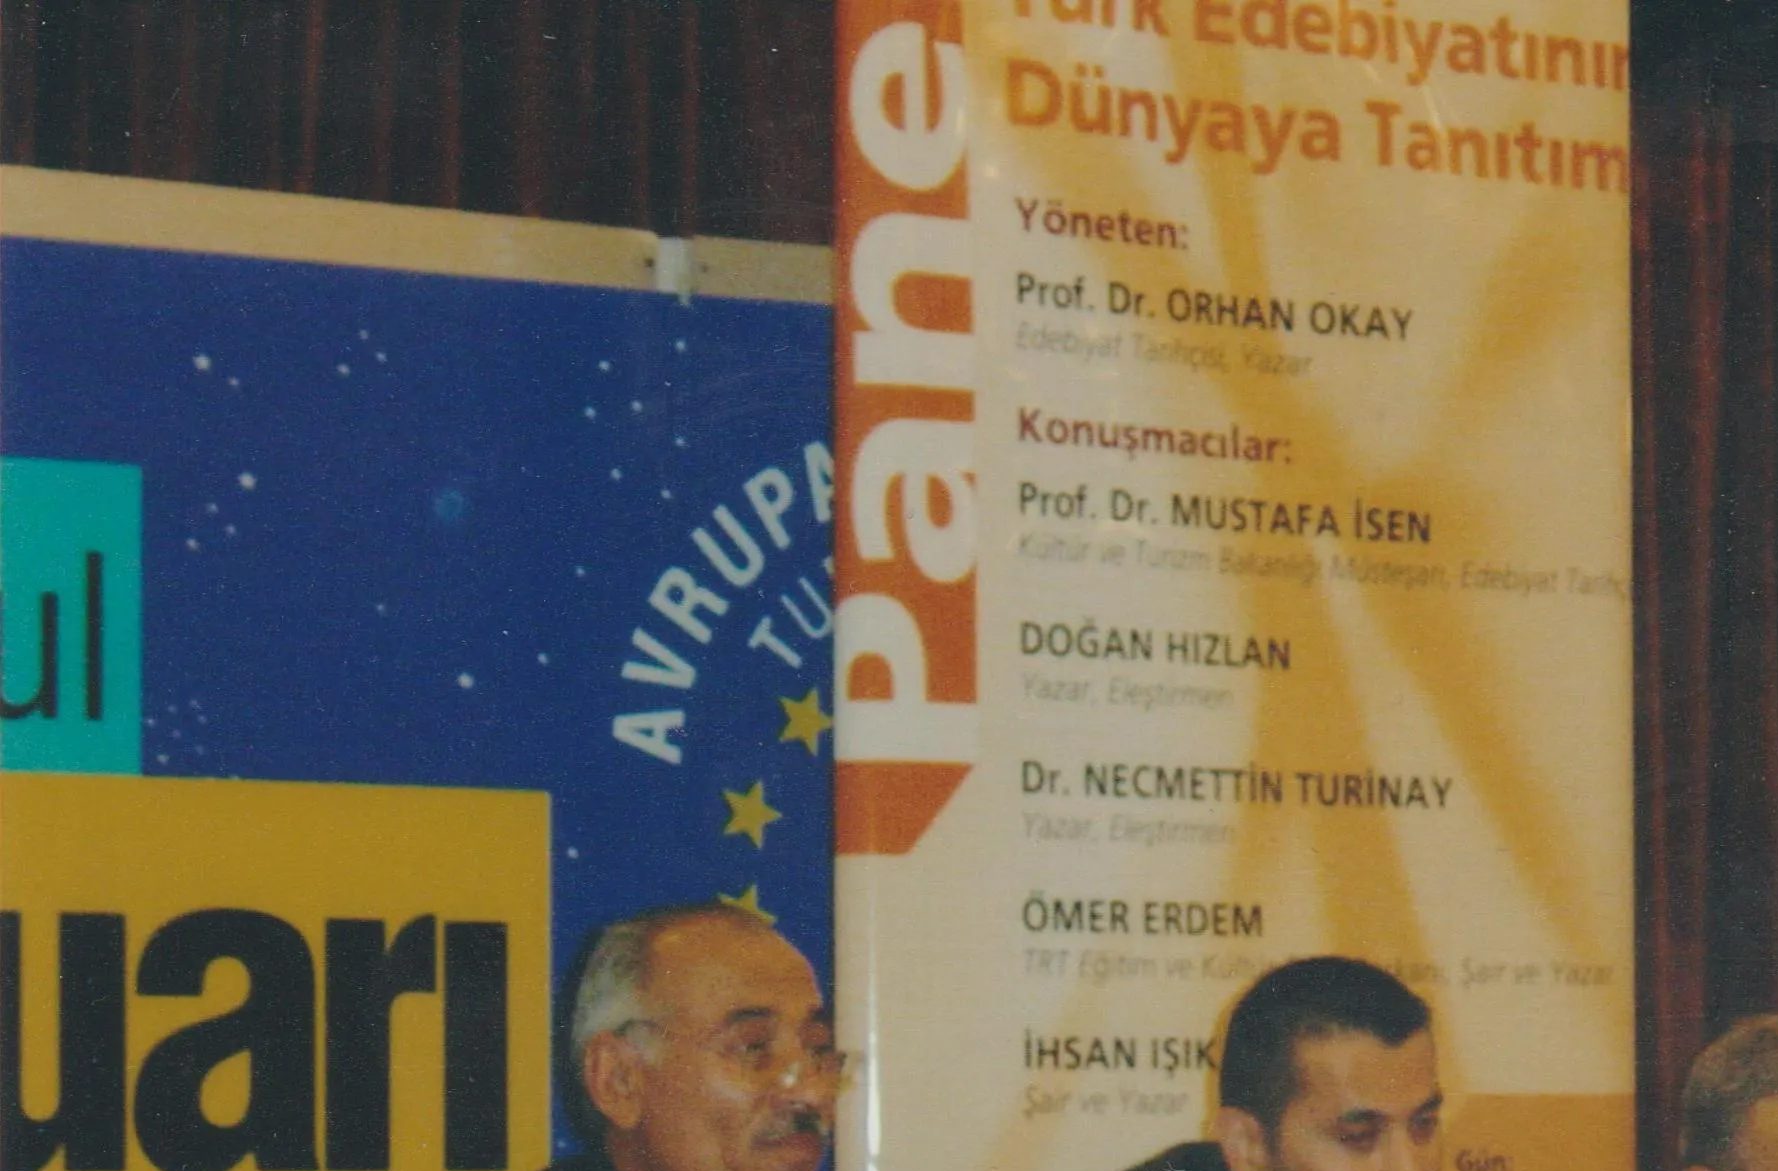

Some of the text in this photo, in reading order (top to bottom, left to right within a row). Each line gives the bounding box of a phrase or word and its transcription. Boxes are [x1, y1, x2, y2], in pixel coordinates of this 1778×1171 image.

[1013, 0, 1170, 37] rk
[1007, 57, 1341, 175] Dünyaya
[1015, 198, 1190, 250] Yöneten:
[1016, 272, 1413, 342] Prof. Dr. ORHAN OKAY
[1017, 407, 1292, 464] Konuşmacılar:
[1018, 481, 1432, 544] Prof. Dr. MUSTAFA İSEN
[612, 441, 834, 765] AVRUPA
[748, 556, 834, 670] TU
[1020, 616, 1291, 670] DOĞAN HIZLAN
[1022, 760, 1452, 808] Dr. NECMETTİN TURİNAY
[1023, 890, 1263, 938] ÖMER ERDEM
[1023, 1027, 1217, 1078] İHSAN IŞIK
